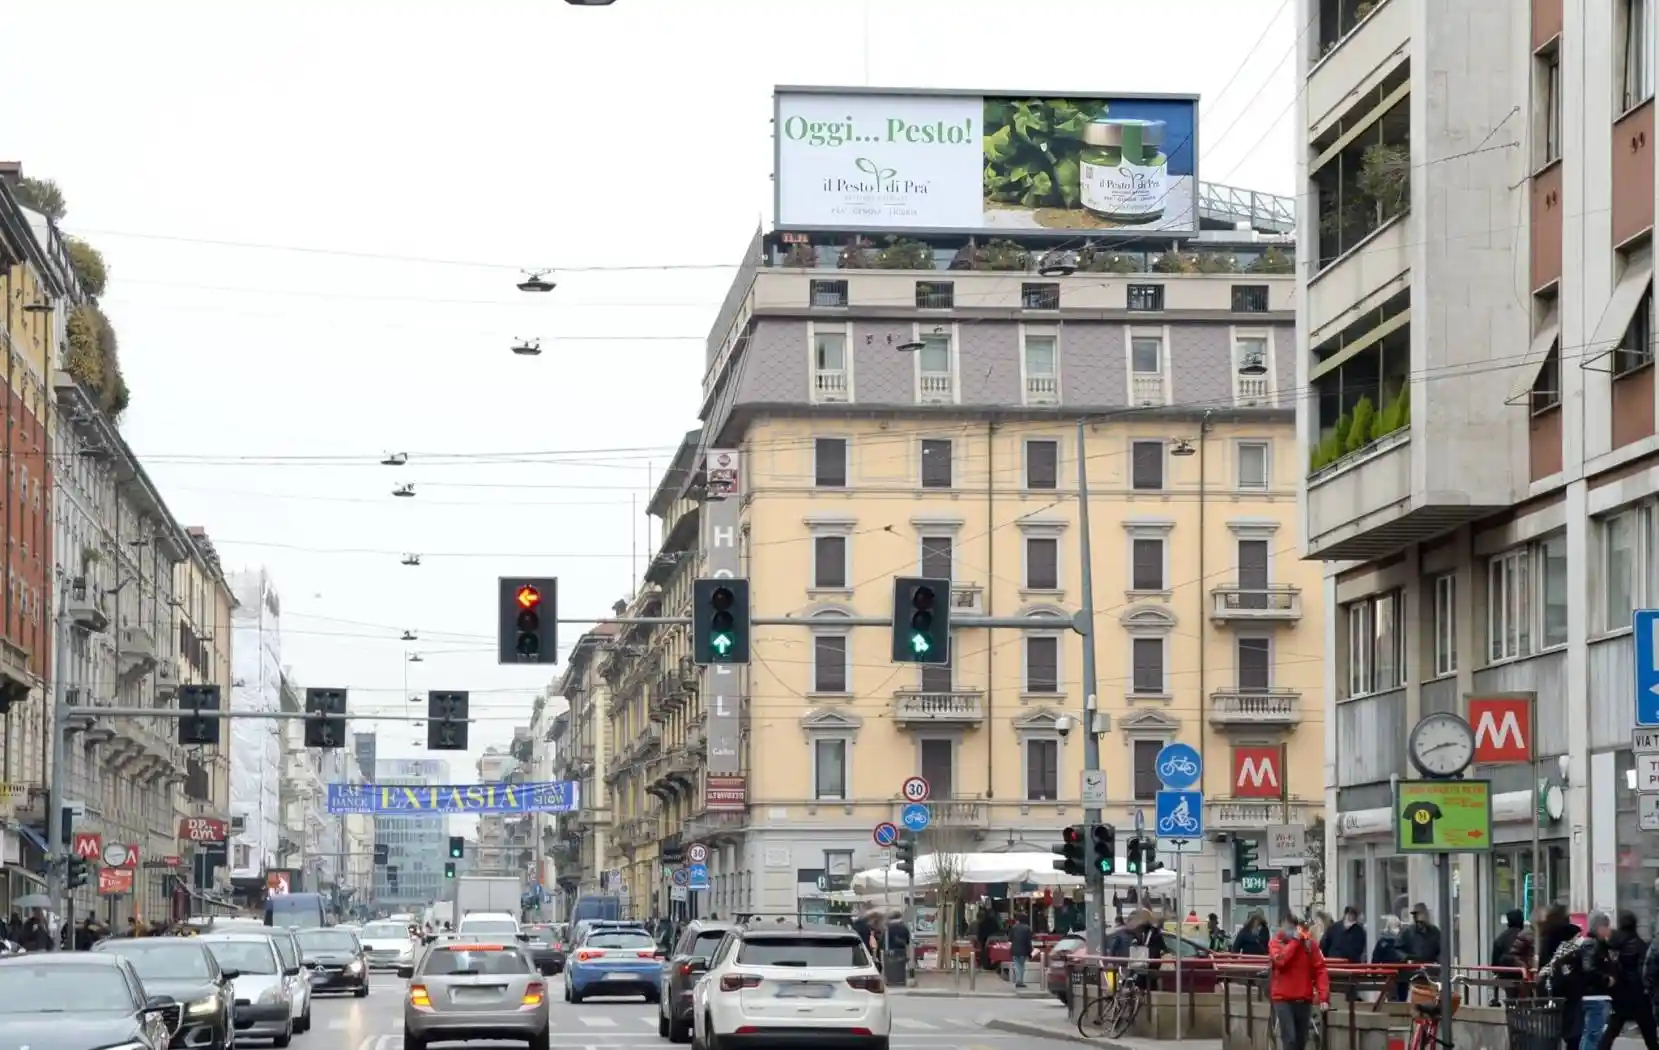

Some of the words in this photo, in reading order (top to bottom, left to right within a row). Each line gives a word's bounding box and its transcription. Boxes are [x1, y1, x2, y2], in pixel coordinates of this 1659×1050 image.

[785, 115, 880, 147] Oggi...
[886, 117, 972, 144] Pesto!
[823, 177, 832, 192] il
[837, 178, 874, 192] Pesto
[885, 179, 900, 193] di
[1475, 710, 1525, 749] M
[1635, 735, 1651, 748] VIA
[1237, 757, 1279, 787] M
[382, 784, 518, 809] EXTASIA
[908, 783, 923, 796] 30
[77, 838, 100, 856] M
[692, 848, 704, 859] 30
